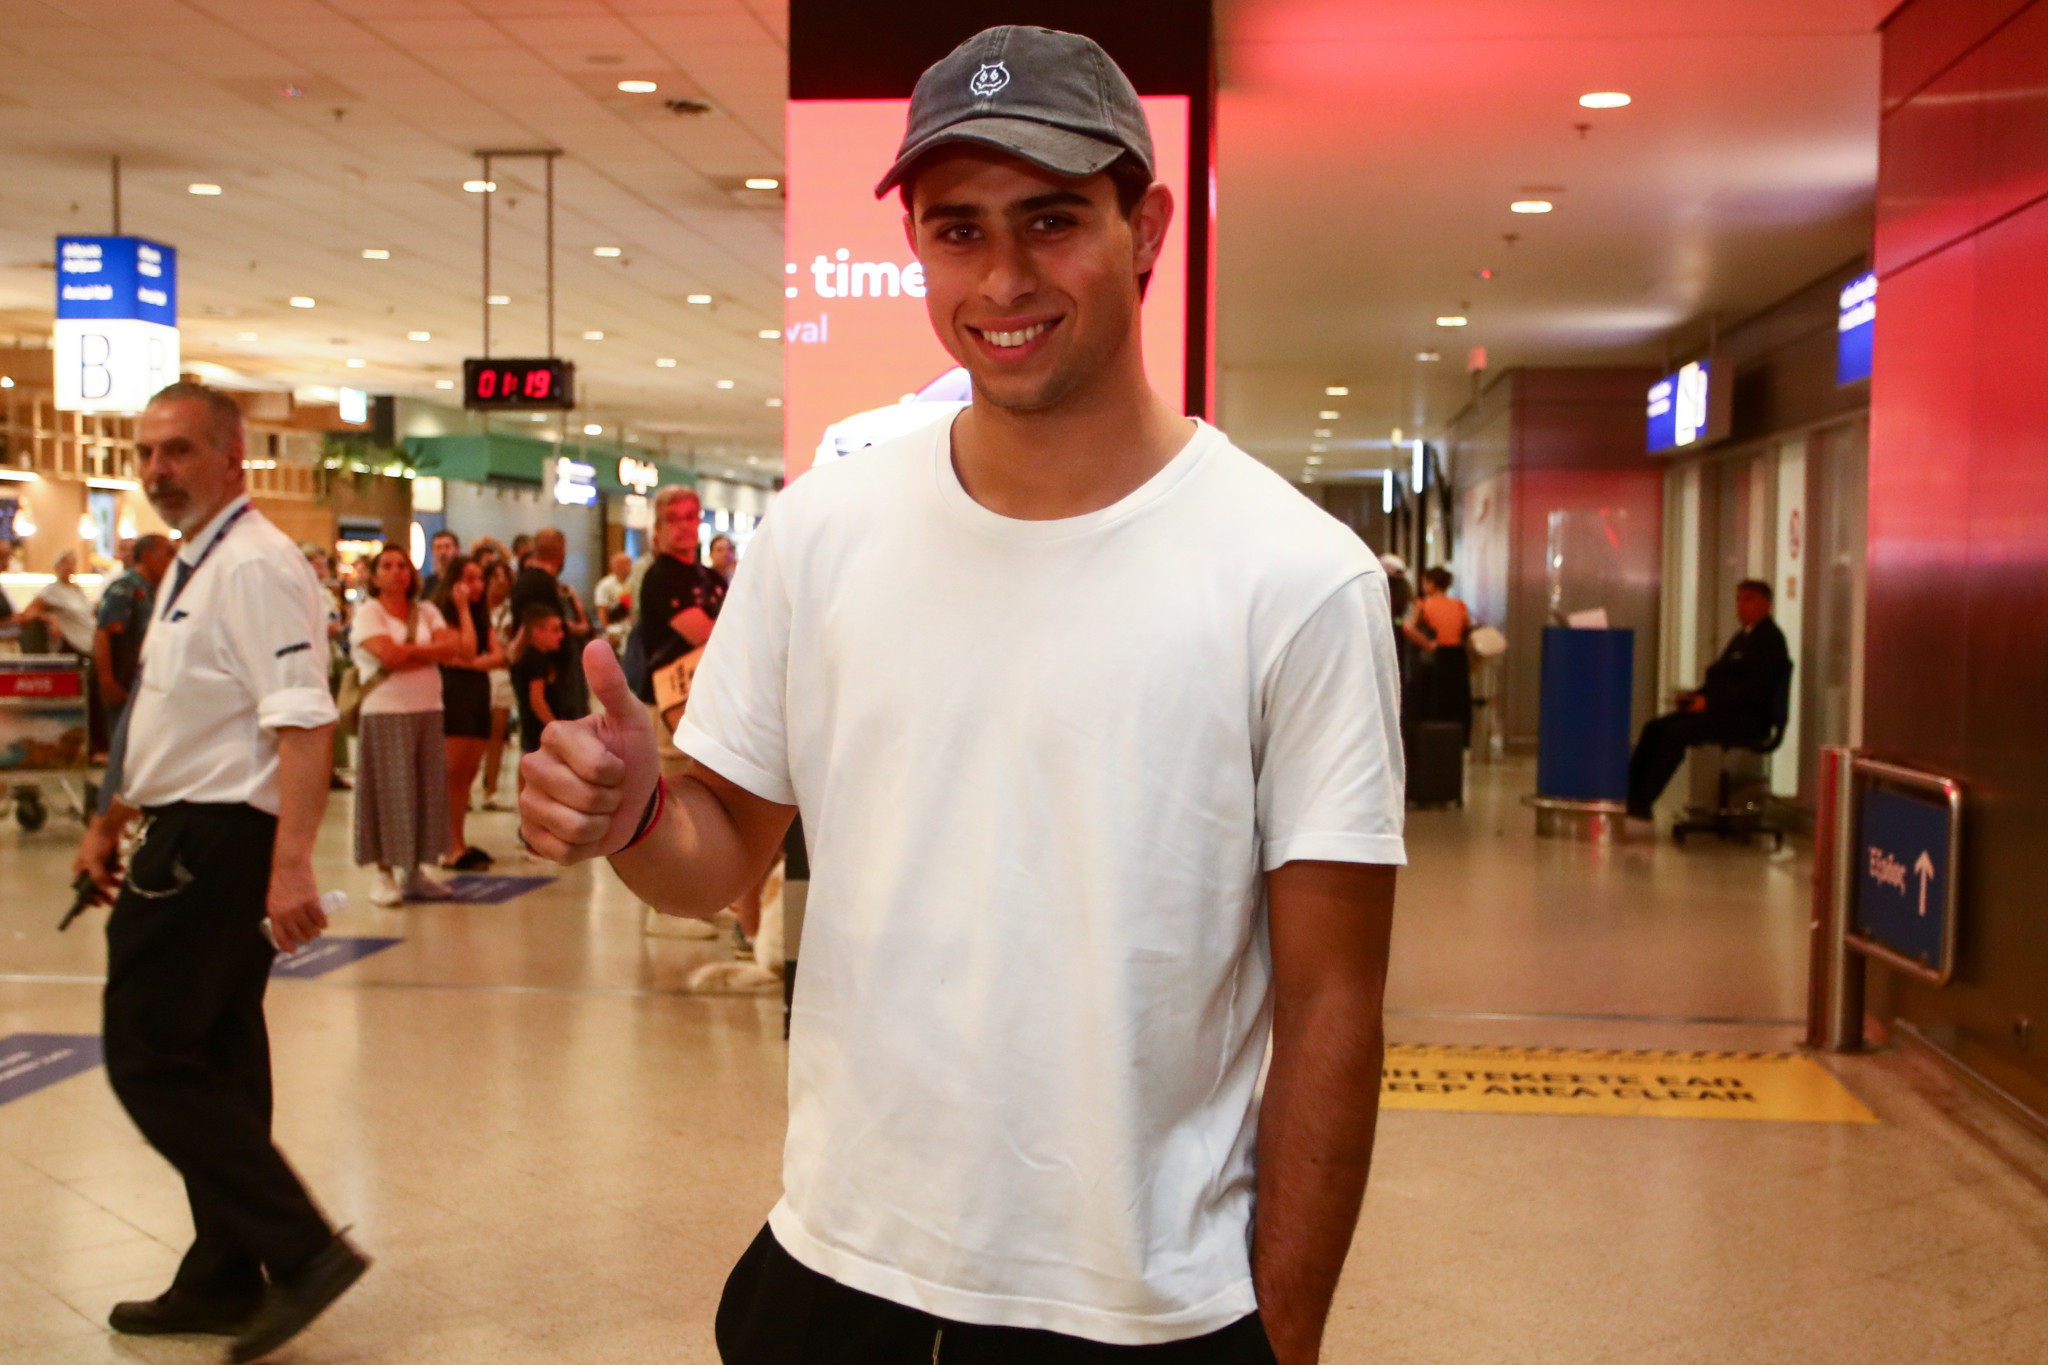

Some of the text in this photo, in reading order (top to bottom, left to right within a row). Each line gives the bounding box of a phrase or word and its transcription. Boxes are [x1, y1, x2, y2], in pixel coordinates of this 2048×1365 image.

[811, 248, 927, 298] time
[81, 334, 111, 398] B
[477, 369, 551, 398] 01:19
[1483, 1083, 1599, 1098] AREA
[1612, 1087, 1757, 1103] CLEAR
